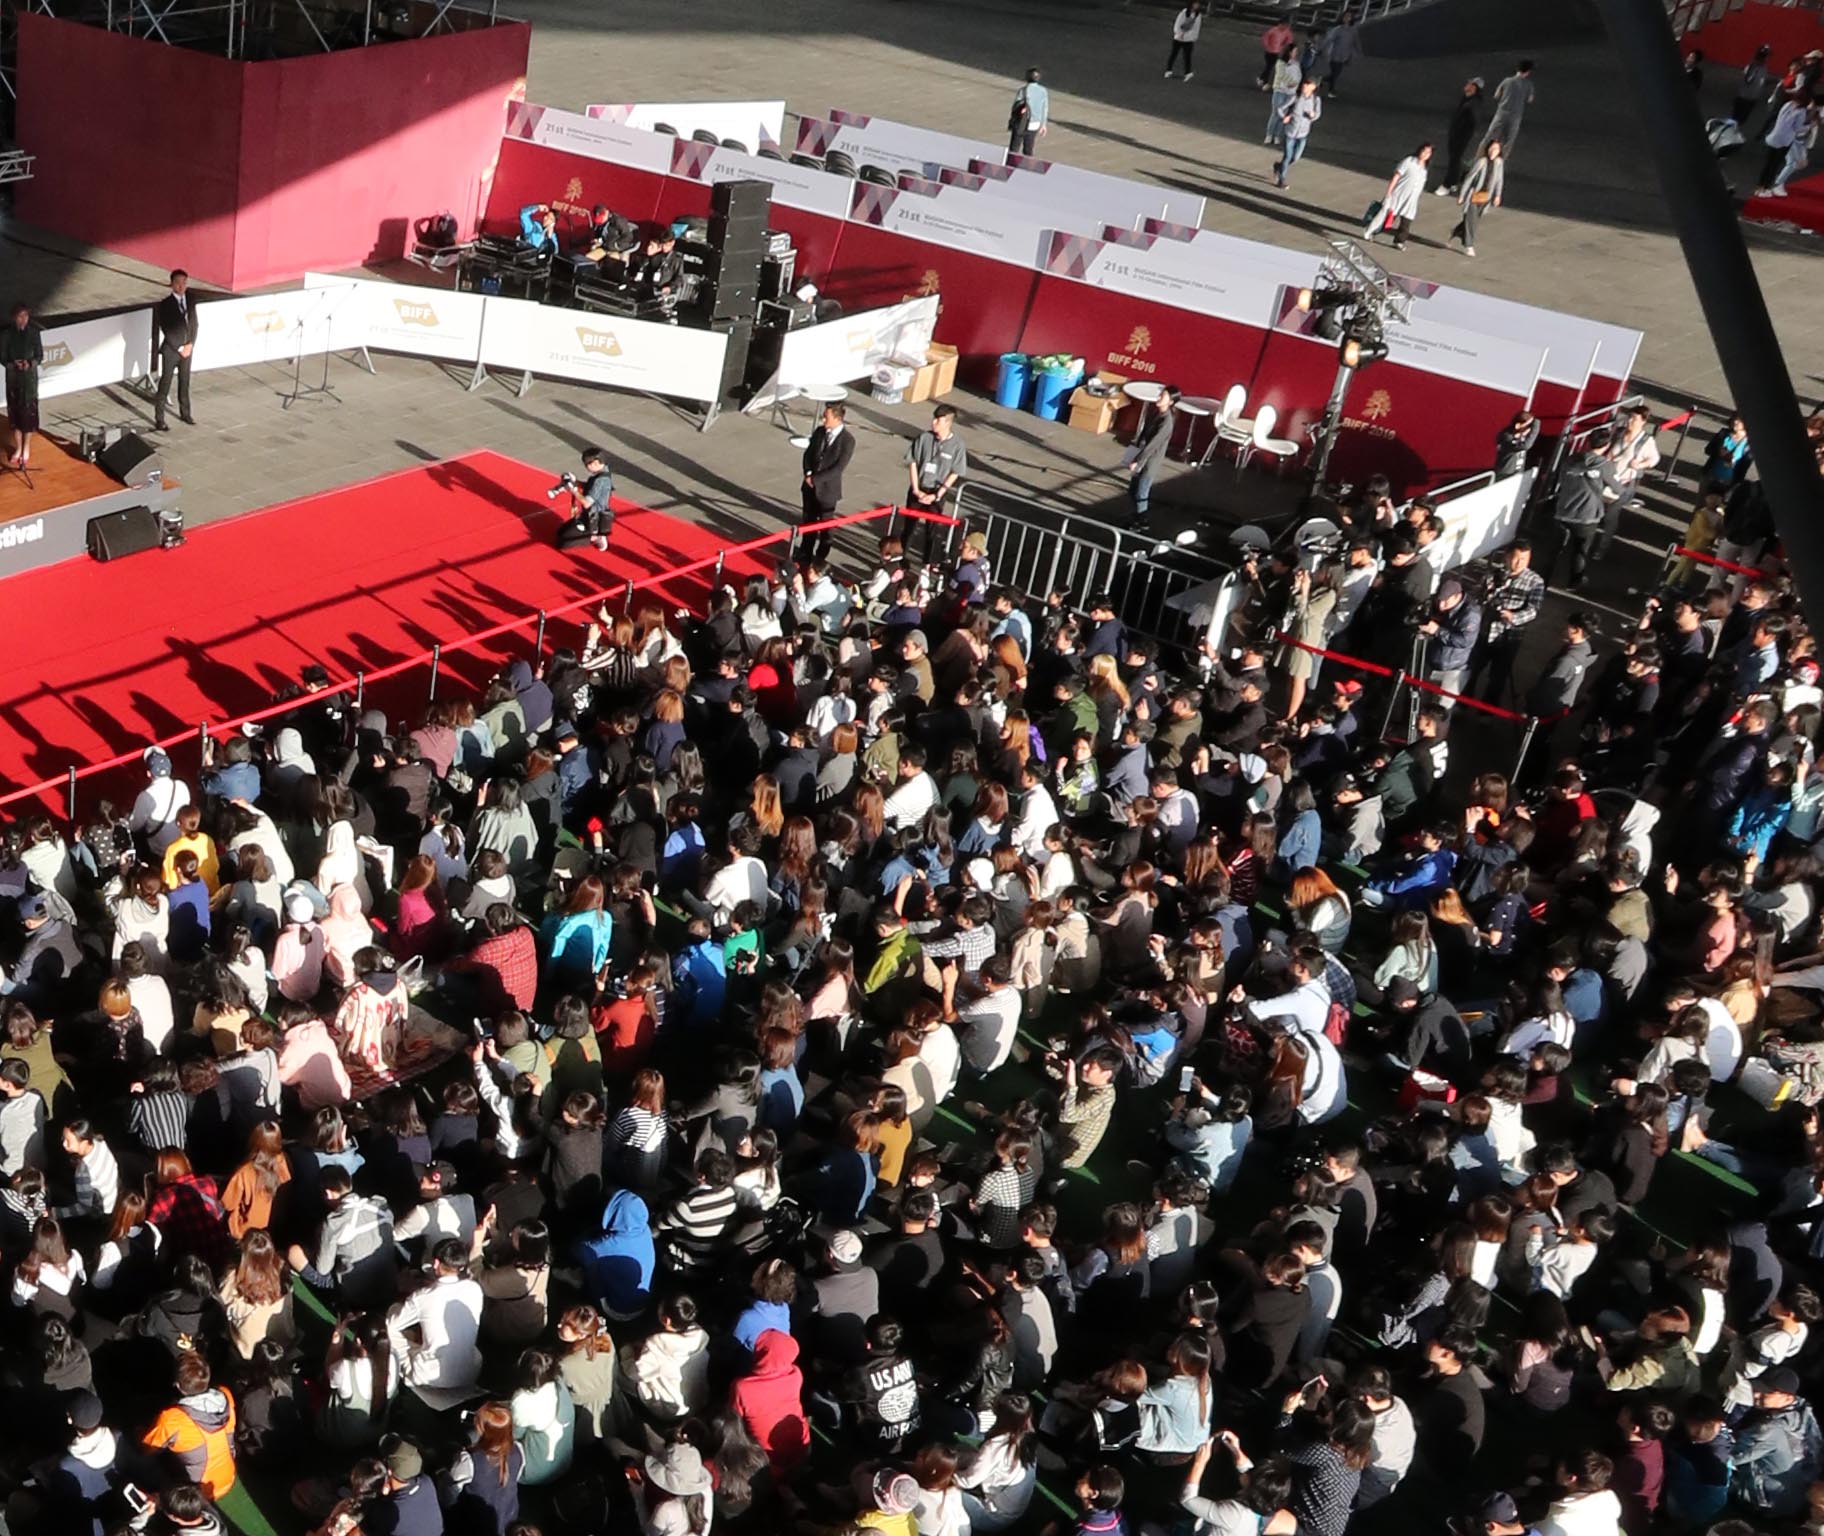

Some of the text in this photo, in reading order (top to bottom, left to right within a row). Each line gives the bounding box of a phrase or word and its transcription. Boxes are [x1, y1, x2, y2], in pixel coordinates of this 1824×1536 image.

[840, 141, 860, 154] 21st
[897, 208, 921, 223] 21st
[1103, 260, 1129, 276] 21st
[399, 304, 432, 321] BIFF
[582, 333, 618, 350] BIFF
[1107, 351, 1157, 374] BIFF 2016
